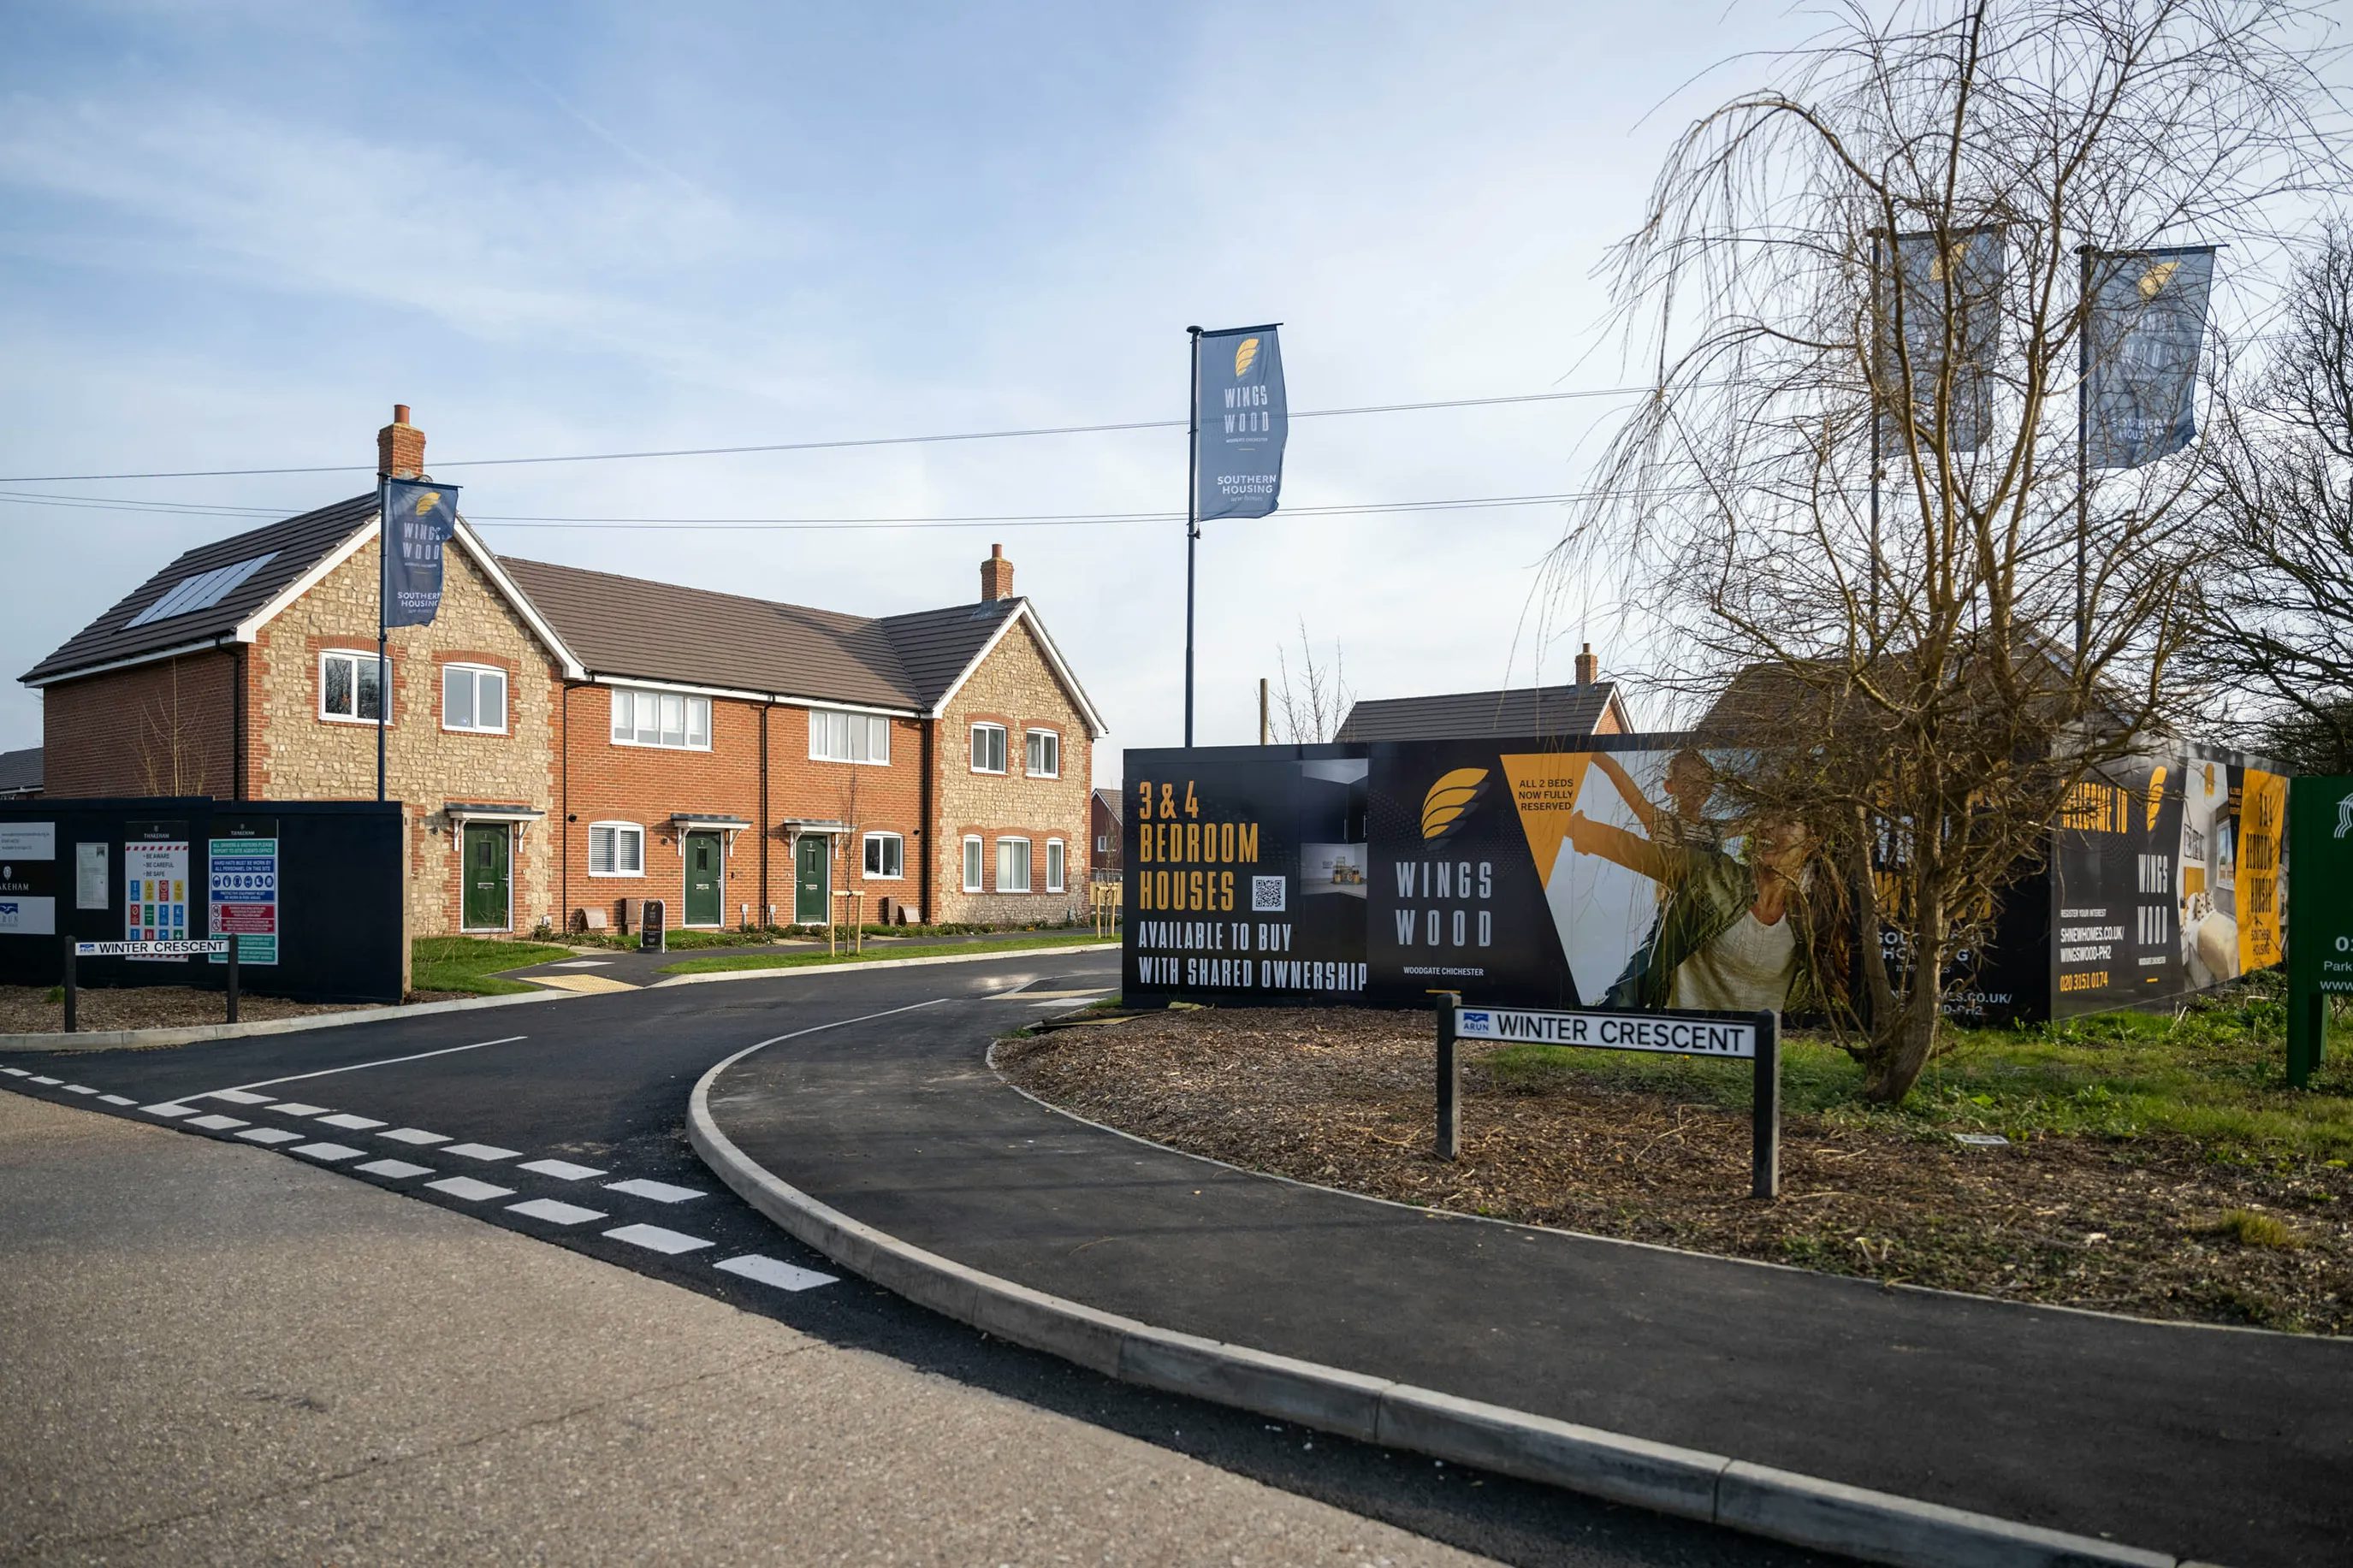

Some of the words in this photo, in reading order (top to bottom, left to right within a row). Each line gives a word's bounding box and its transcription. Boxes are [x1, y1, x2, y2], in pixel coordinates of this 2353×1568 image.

[1224, 385, 1267, 408] WINGS
[1224, 411, 1269, 434] WOOD
[2119, 428, 2166, 441] HOUS
[1217, 475, 1277, 485] SOUTHERN
[1222, 484, 1273, 494] HOUSING
[403, 541, 440, 560] WOOD
[1520, 779, 1537, 788] ALL
[1547, 778, 1574, 787] BEDS
[1139, 781, 1152, 820] 3
[1159, 784, 1177, 819] &
[1185, 780, 1199, 819] 4
[1544, 790, 1574, 799] FULLY
[1520, 802, 1572, 811] RESERVED
[2117, 787, 2128, 834] TO
[1140, 823, 1259, 863] BEDROOM
[1396, 861, 1492, 898] WINGS
[2138, 854, 2167, 893] WINGS
[1140, 871, 1234, 911] HOUSES
[1396, 909, 1491, 947] WOOD
[2060, 926, 2125, 943] SHNEWHOMES.CO.UK/
[2137, 906, 2167, 944] WOOD
[1138, 920, 1223, 950] AVAILABLE
[1232, 923, 1249, 950] TO
[1259, 923, 1291, 951] BUY
[2335, 936, 2353, 951] 0
[99, 943, 149, 953] WINTER
[154, 941, 224, 952] CRESCENT
[2060, 945, 2112, 962] WINGSWOOD-PH2
[1138, 957, 1178, 985] WITH
[1188, 958, 1253, 987] SHARED
[1262, 960, 1367, 991] OWNERSHIP
[1403, 967, 1440, 975] WOODGATE
[1442, 967, 1484, 976] CHICHESTER
[2324, 961, 2353, 972] Park
[2060, 974, 2072, 991] 020
[2073, 973, 2089, 991] 3151
[2091, 971, 2108, 988] 0174
[1464, 1022, 1489, 1031] ARUN
[1497, 1014, 1587, 1041] WINTER
[1600, 1021, 1745, 1051] CRESCENT
